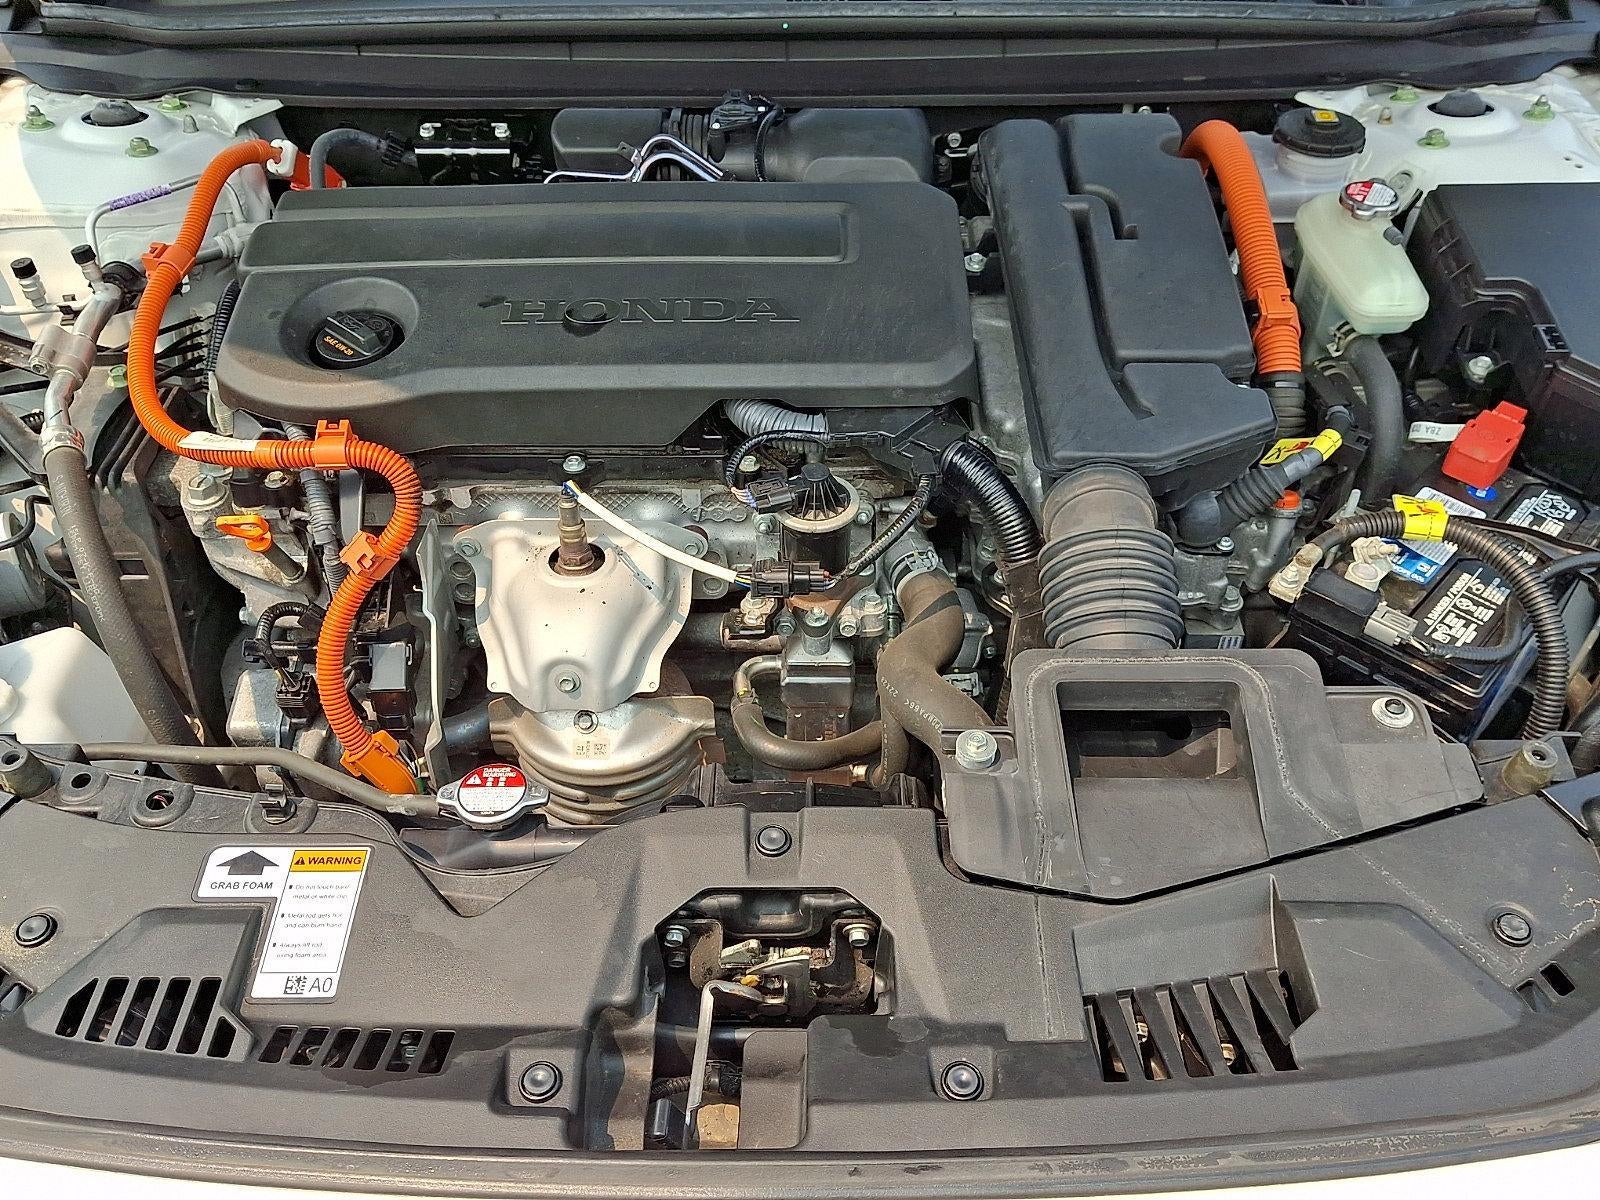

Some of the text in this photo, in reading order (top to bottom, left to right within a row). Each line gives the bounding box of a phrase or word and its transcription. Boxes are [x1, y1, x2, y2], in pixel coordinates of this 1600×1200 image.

[500, 297, 800, 324] HONDA
[323, 335, 337, 346] SAE
[307, 856, 362, 865] WARNING
[210, 881, 274, 890] GRAB FOAM
[308, 976, 333, 993] A0
